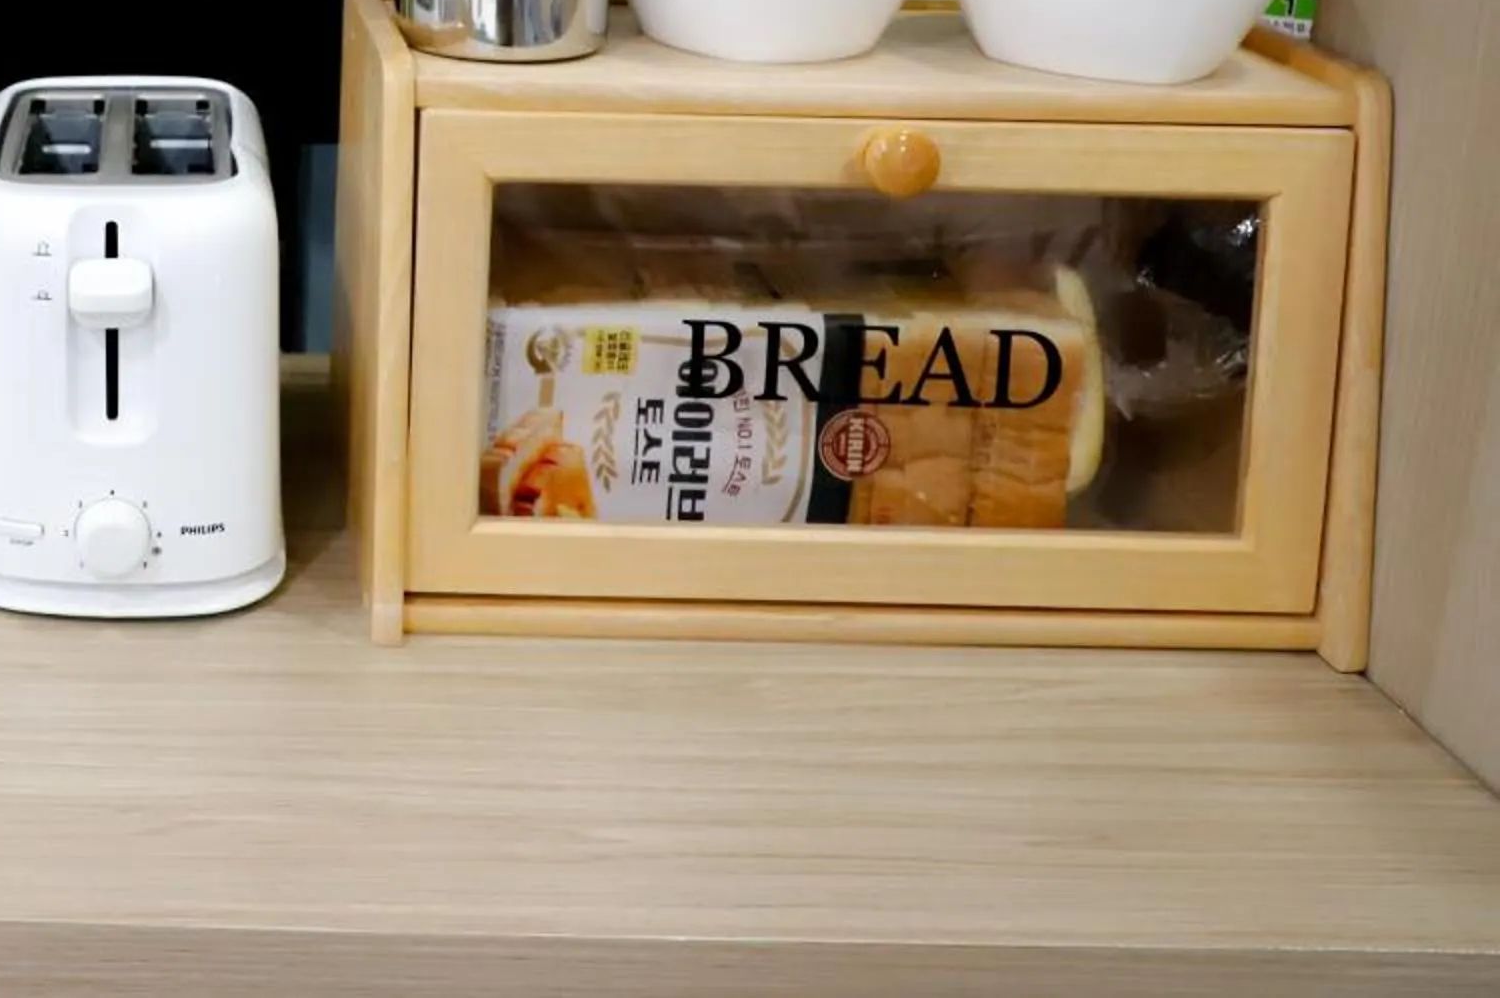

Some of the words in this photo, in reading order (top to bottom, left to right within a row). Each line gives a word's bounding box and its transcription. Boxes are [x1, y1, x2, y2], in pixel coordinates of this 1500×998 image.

[682, 318, 1063, 410] BREAD
[631, 397, 665, 485] 토스트
[846, 417, 865, 473] KIRIN
[179, 522, 226, 537] PHILIPS
